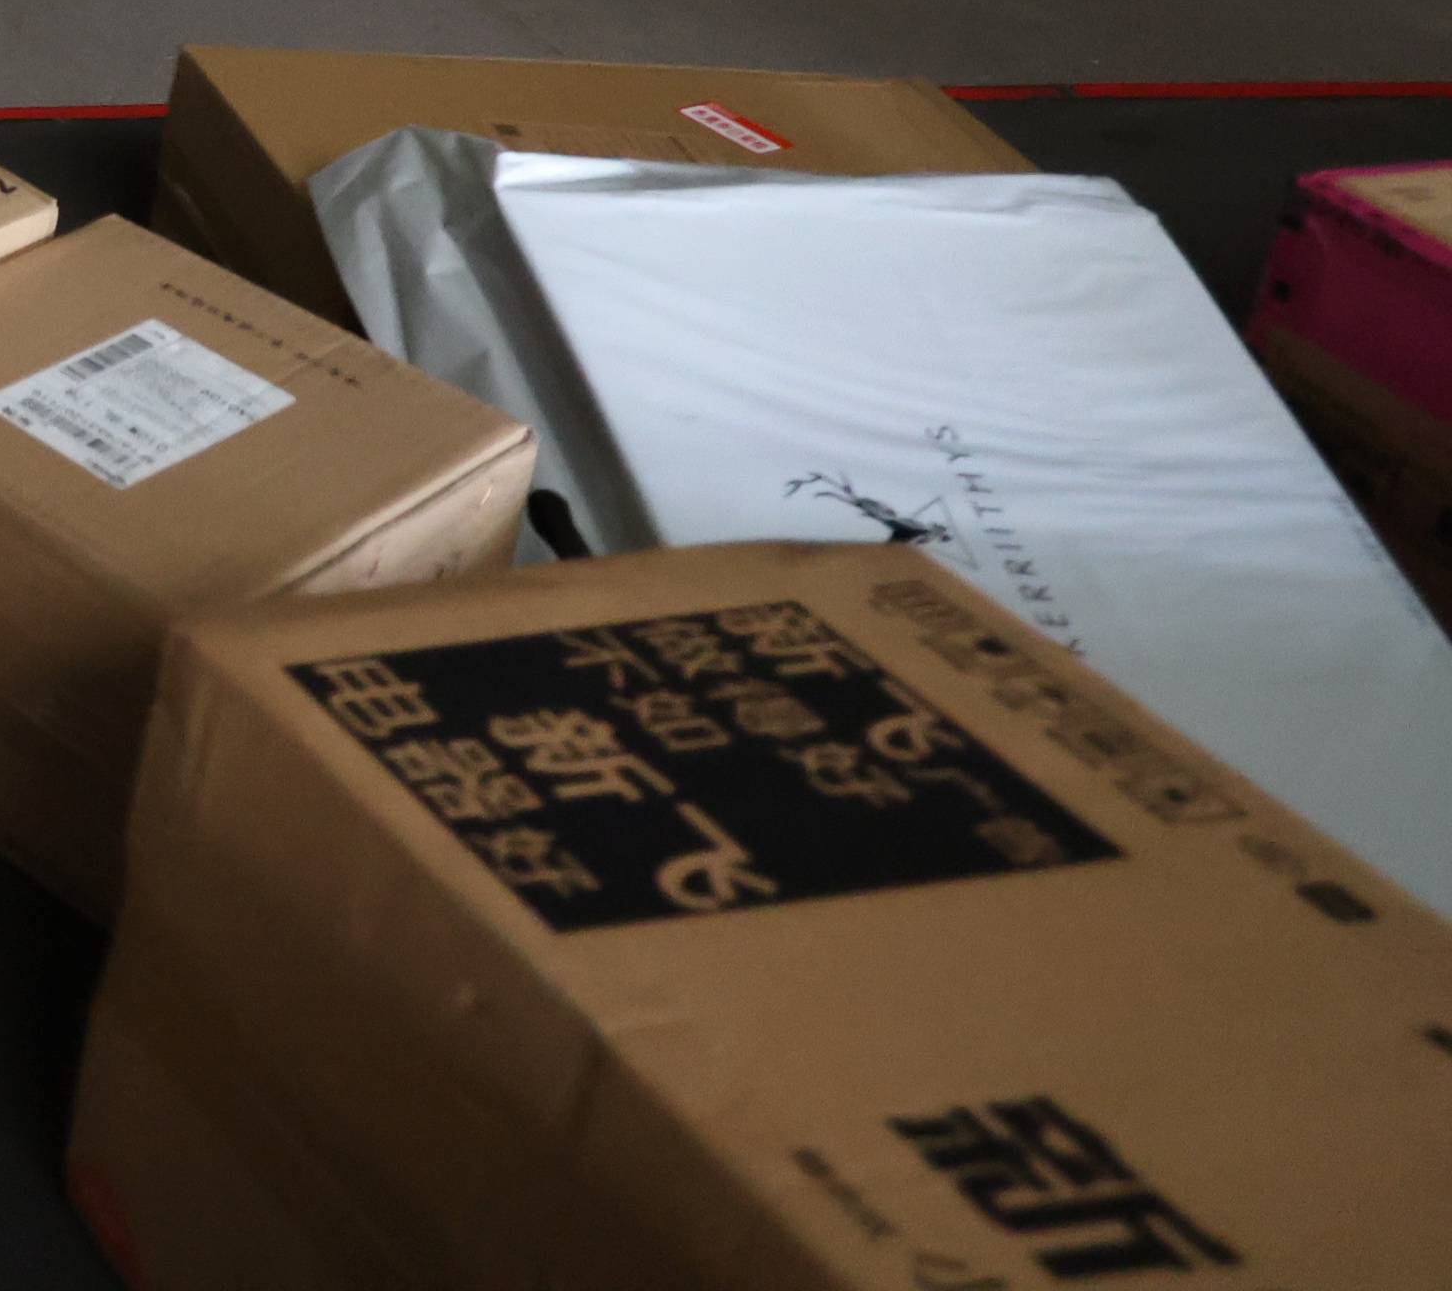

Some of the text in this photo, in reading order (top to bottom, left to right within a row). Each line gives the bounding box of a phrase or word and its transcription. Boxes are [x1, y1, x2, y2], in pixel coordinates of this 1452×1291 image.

[314, 660, 602, 899] 电器好
[487, 707, 782, 911] 新飞
